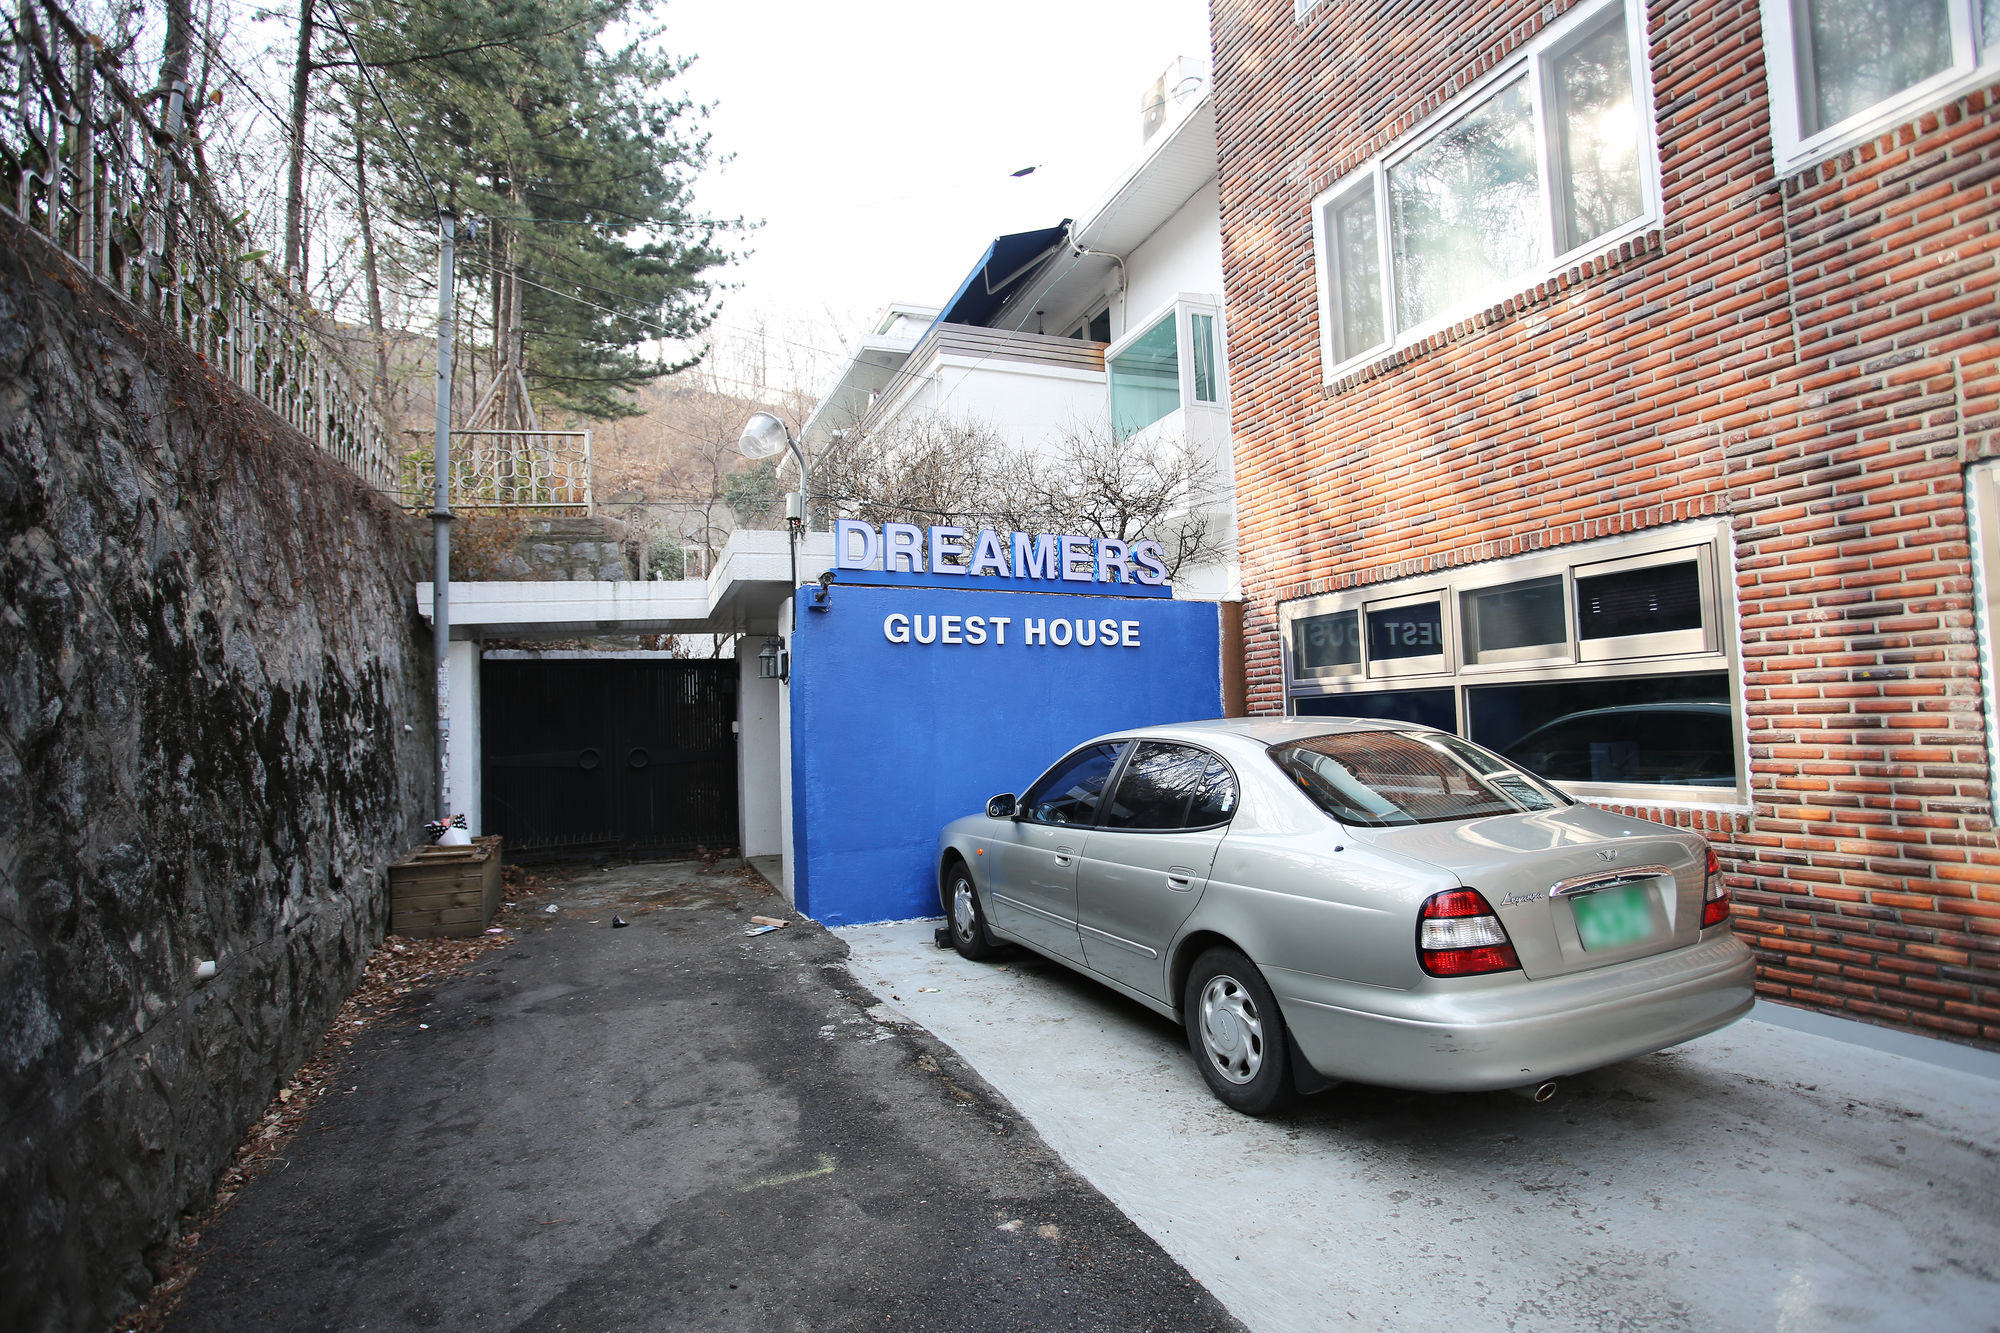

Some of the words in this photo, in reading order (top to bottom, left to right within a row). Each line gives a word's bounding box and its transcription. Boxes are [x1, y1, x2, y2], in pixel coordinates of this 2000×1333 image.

[835, 518, 1168, 586] DREAMERS
[883, 613, 1011, 645] GUEST
[1024, 617, 1141, 647] HOUSE
